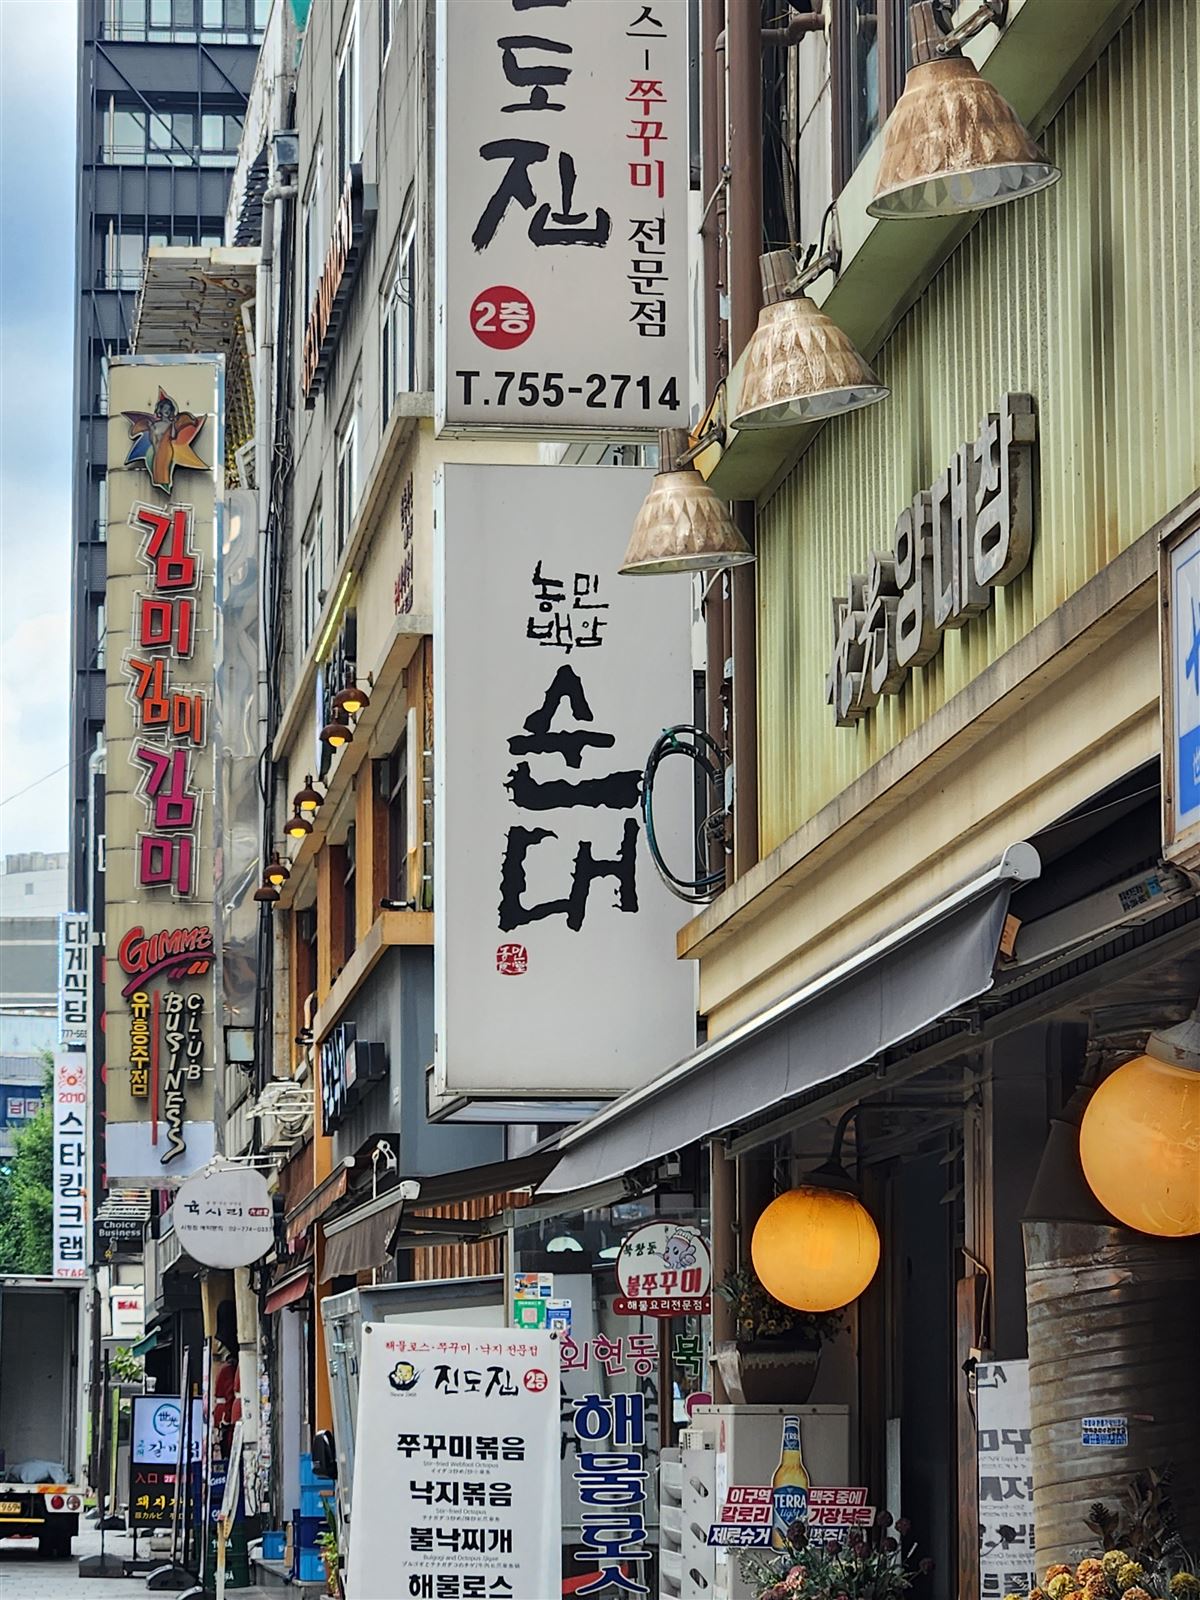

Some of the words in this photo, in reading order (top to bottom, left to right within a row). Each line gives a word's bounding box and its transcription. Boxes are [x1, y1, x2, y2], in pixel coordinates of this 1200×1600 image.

[471, 0, 612, 253] 도집
[626, 207, 669, 338] 전문점
[475, 301, 530, 335] 2층
[456, 370, 681, 411] T.755-2714
[526, 612, 608, 655] 백암
[498, 664, 645, 932] 순대
[131, 991, 150, 1098] 유흥주점
[160, 991, 187, 1165] BUSINESS
[59, 1092, 86, 1103] 2010
[59, 1111, 86, 1261] 스타킹크랩
[99, 1229, 141, 1238] Business
[103, 1221, 136, 1229] Choice
[397, 1433, 525, 1461] 쭈꾸미볶음
[409, 1480, 512, 1507] 낙지볶음
[774, 1493, 807, 1508] TERRA
[720, 1506, 771, 1523] 칼로리
[410, 1527, 512, 1553] 불낙찌개
[408, 1573, 513, 1600] 해물로스
